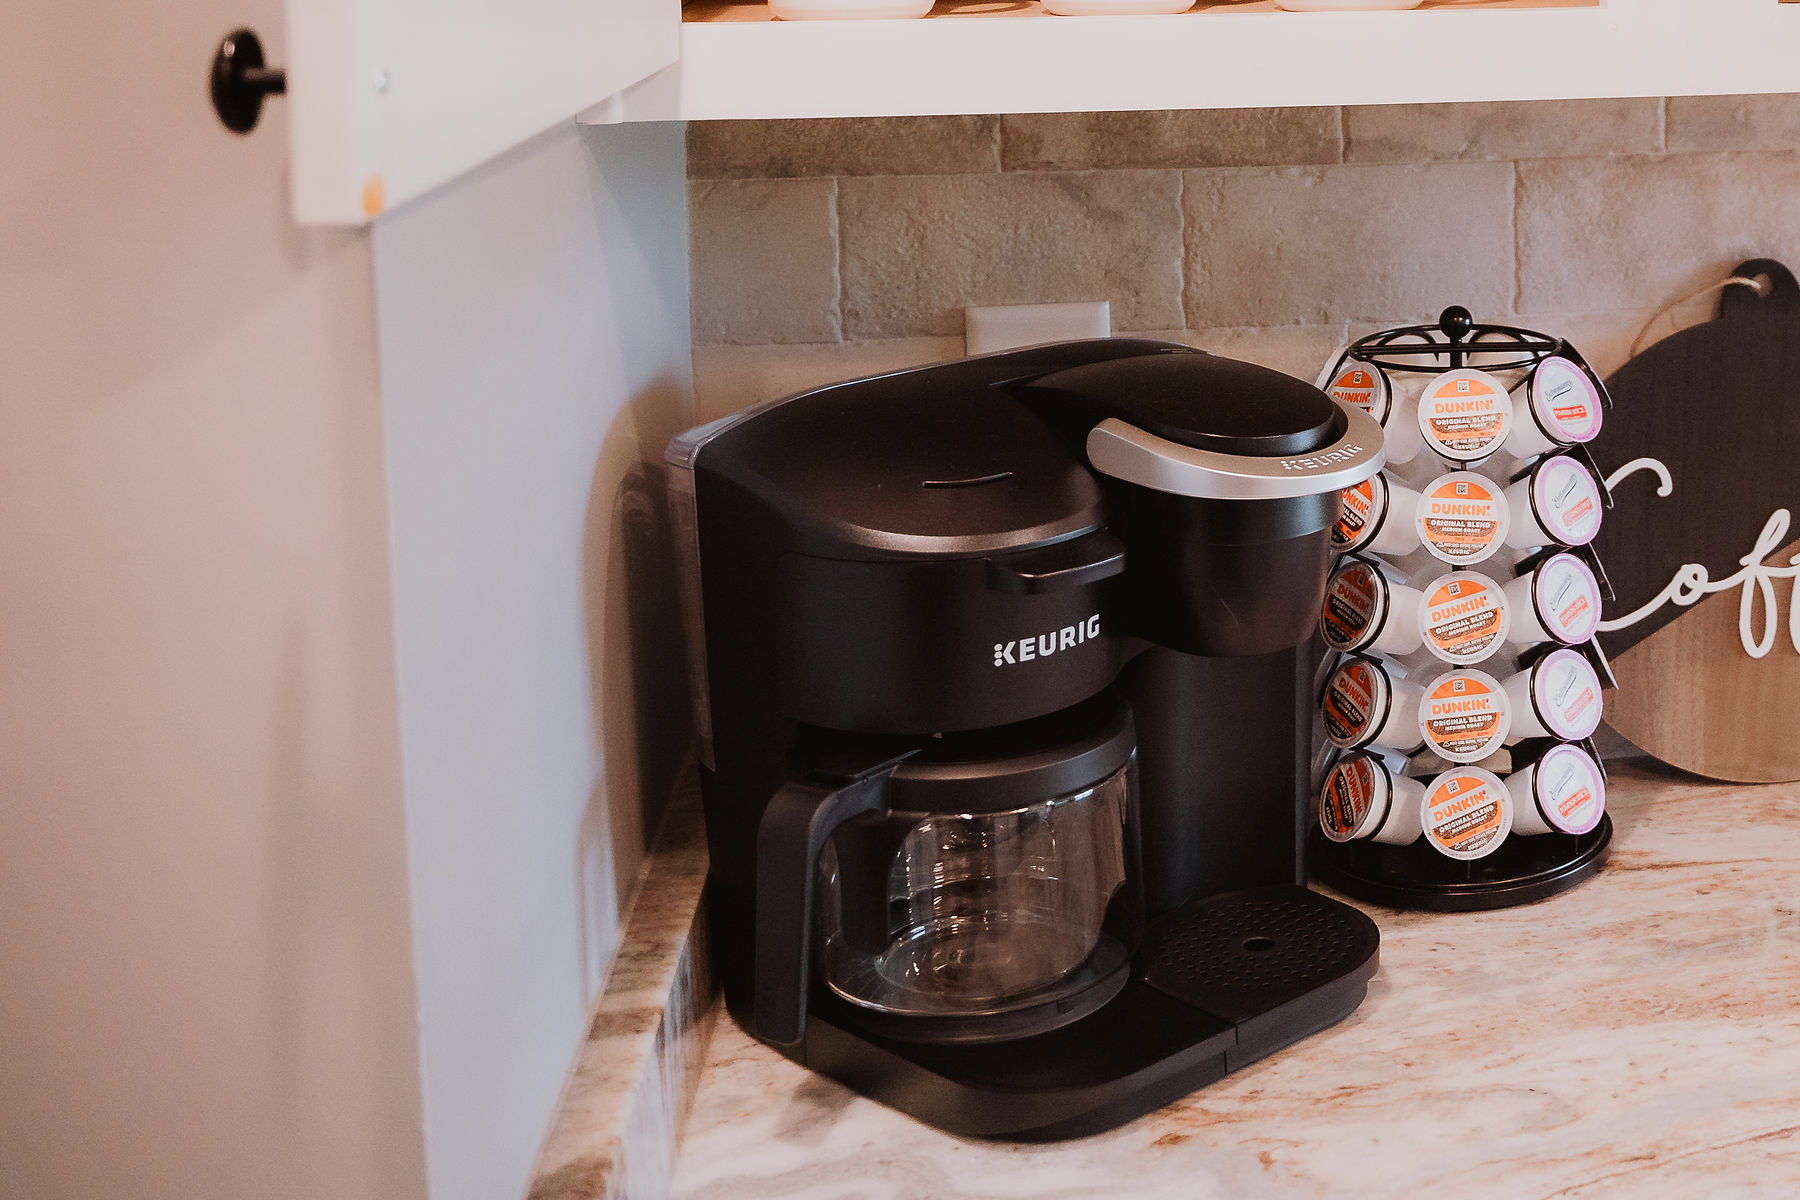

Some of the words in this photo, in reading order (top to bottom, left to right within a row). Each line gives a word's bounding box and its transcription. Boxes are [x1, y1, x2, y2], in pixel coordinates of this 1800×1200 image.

[1434, 399, 1493, 414] DUNKIN'
[1435, 418, 1471, 426] ORIGINAL
[1472, 415, 1496, 423] BLEND
[1280, 443, 1363, 470] KEURIG
[1431, 503, 1491, 516] DUNKIN'
[1431, 595, 1487, 623] DUNKIN'
[1435, 619, 1470, 635] ORIGINAL
[1470, 611, 1494, 623] BLEND
[994, 613, 1100, 667] KEURIG
[1432, 698, 1489, 715] DUNKIN'
[1433, 717, 1468, 727] ORIGINAL
[1468, 714, 1493, 723] BLEND
[1433, 789, 1486, 822] DUNKIN'
[1439, 816, 1472, 833] ORIGINAL
[1471, 804, 1494, 819] BLEND
